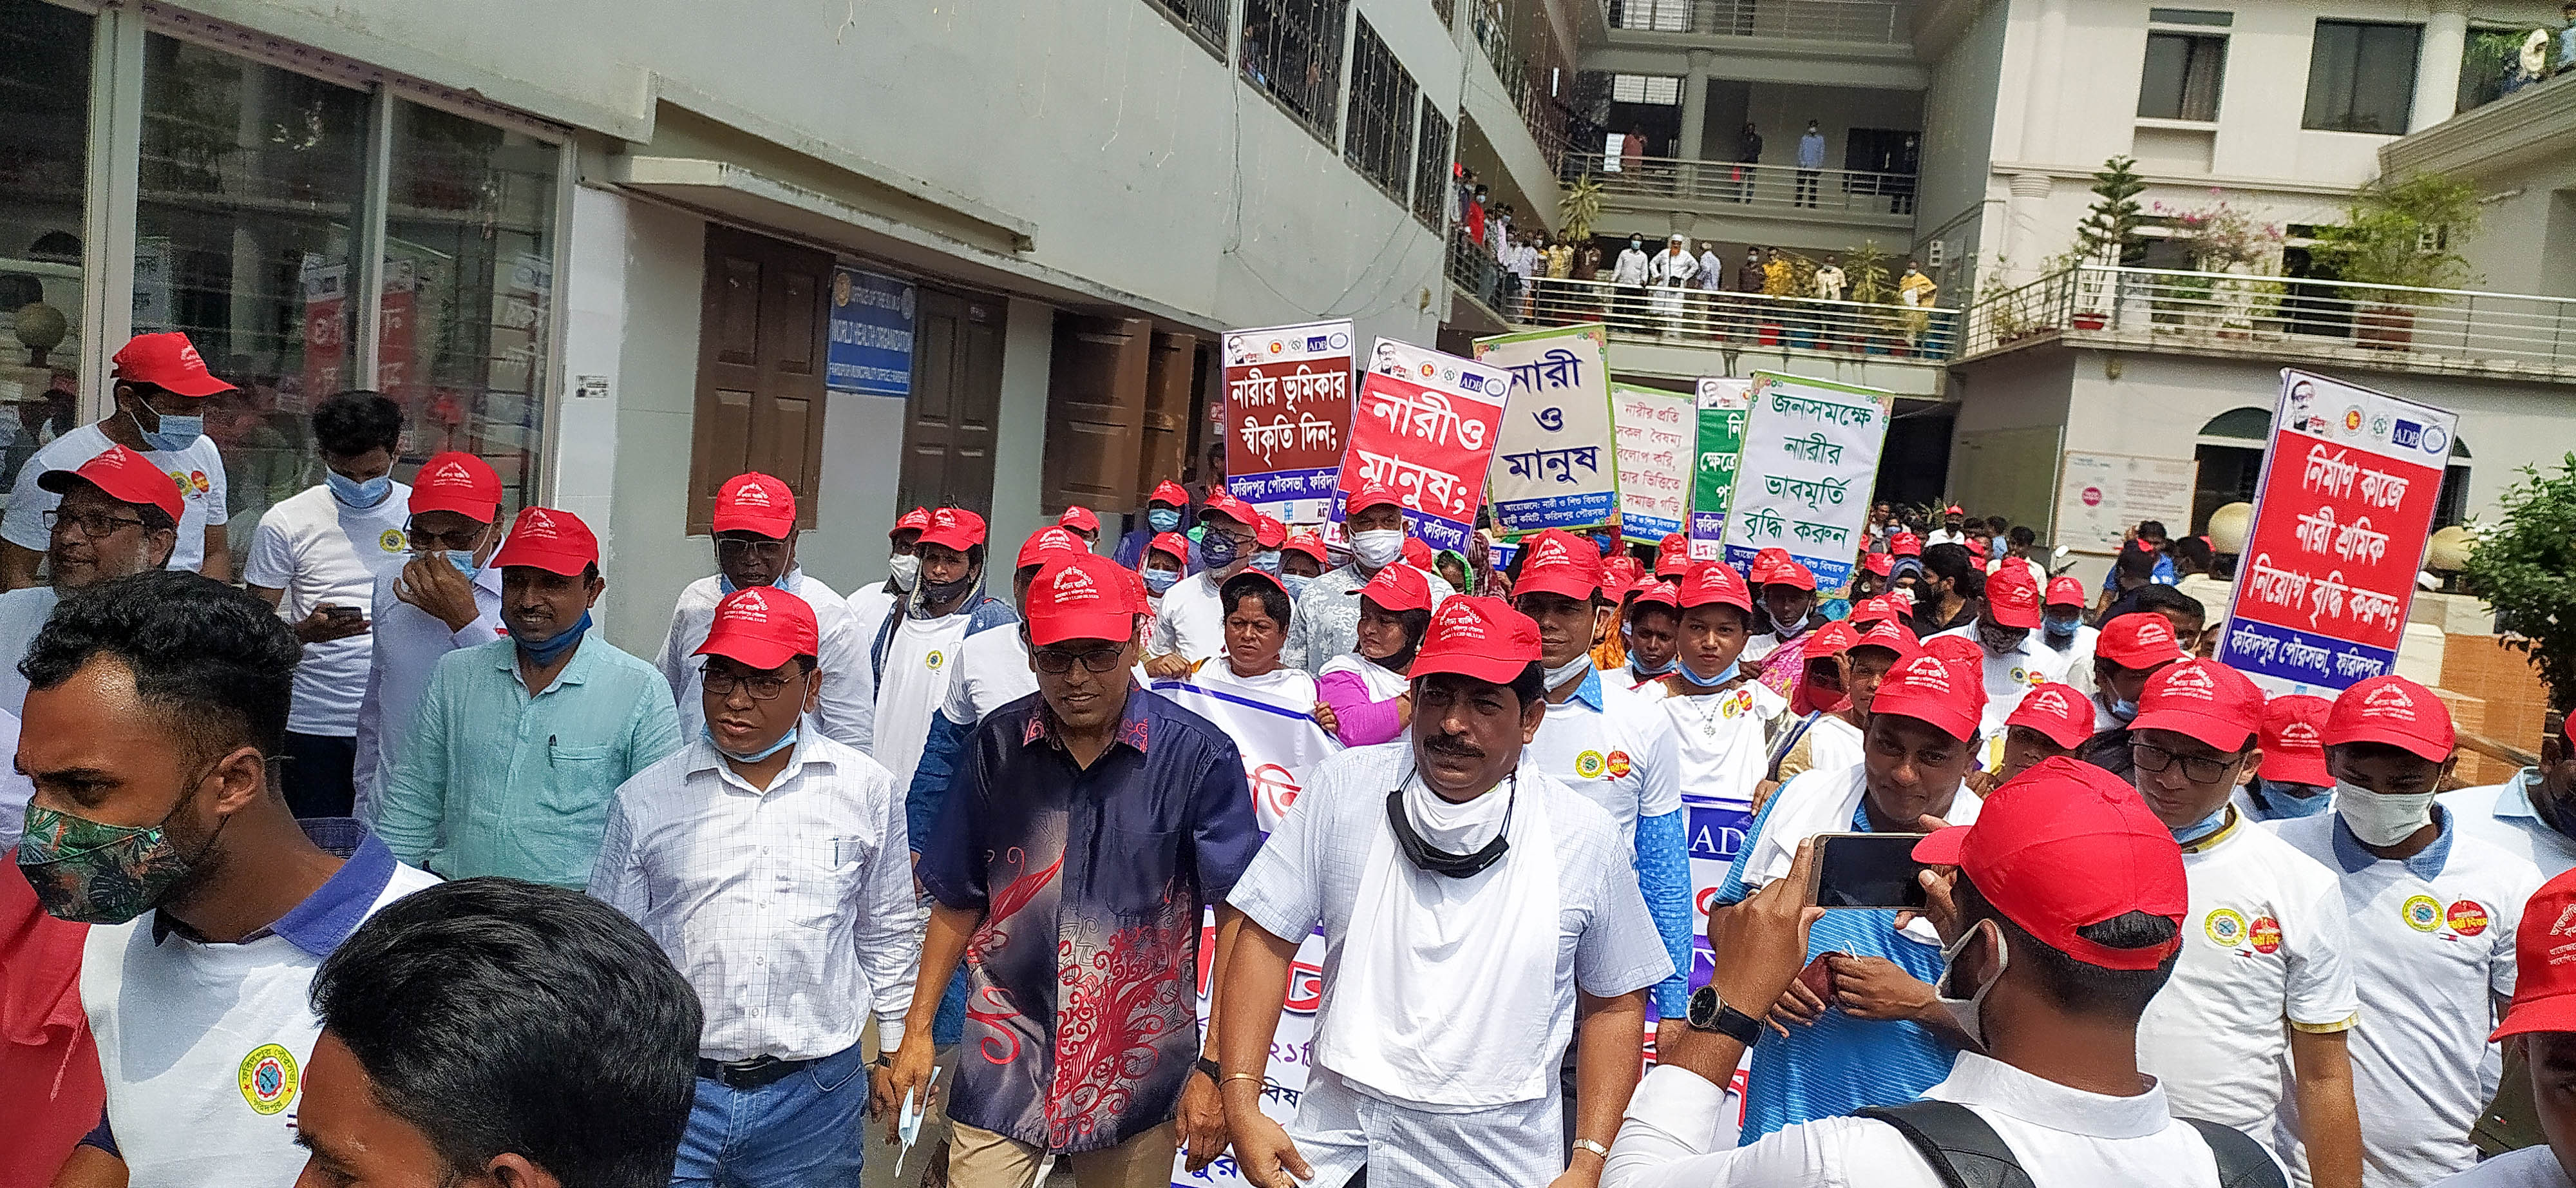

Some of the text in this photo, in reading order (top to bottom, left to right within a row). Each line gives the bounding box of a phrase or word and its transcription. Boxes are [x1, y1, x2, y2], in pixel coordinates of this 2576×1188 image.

[1308, 341, 1327, 352] ADB
[1230, 363, 1348, 414] নারীর ভূমিকার
[1461, 378, 1482, 392] ADB
[1506, 349, 1584, 394] নারী
[1372, 390, 1486, 451] নারীও
[1532, 407, 1565, 432] ও
[1625, 401, 1680, 425] নারীর প্রতি
[1770, 392, 1875, 429] জনসমক্ষে
[1240, 416, 1296, 468] স্বীকৃতি
[1298, 412, 1338, 453] দিন;
[1616, 426, 1682, 448] সকল বৈষম্য
[1783, 432, 1844, 466] নারীর
[2394, 428, 2420, 446] ADB
[1356, 449, 1468, 515] মানুষ;
[1501, 445, 1600, 484] মানুষ
[1642, 470, 1681, 492] ভিত্তিতে
[2303, 444, 2410, 513] নির্মাণ কাজে
[1231, 477, 1265, 499] ফরিদপুর
[1267, 474, 1307, 495] পৌরসভা,
[1542, 498, 1557, 509] নারী
[1567, 497, 1582, 506] শিশু
[1625, 493, 1656, 509] সমাজ
[1764, 474, 1852, 512] ভাবমূর্তি
[1744, 508, 1850, 550] বৃদ্ধি করুন
[2295, 506, 2390, 566] নারী শ্রমিক
[2248, 553, 2400, 632] নিয়োগ বৃদ্ধি করুন;
[2230, 624, 2280, 667] ফরিদপুর
[2278, 634, 2331, 678] পৌরসভা,
